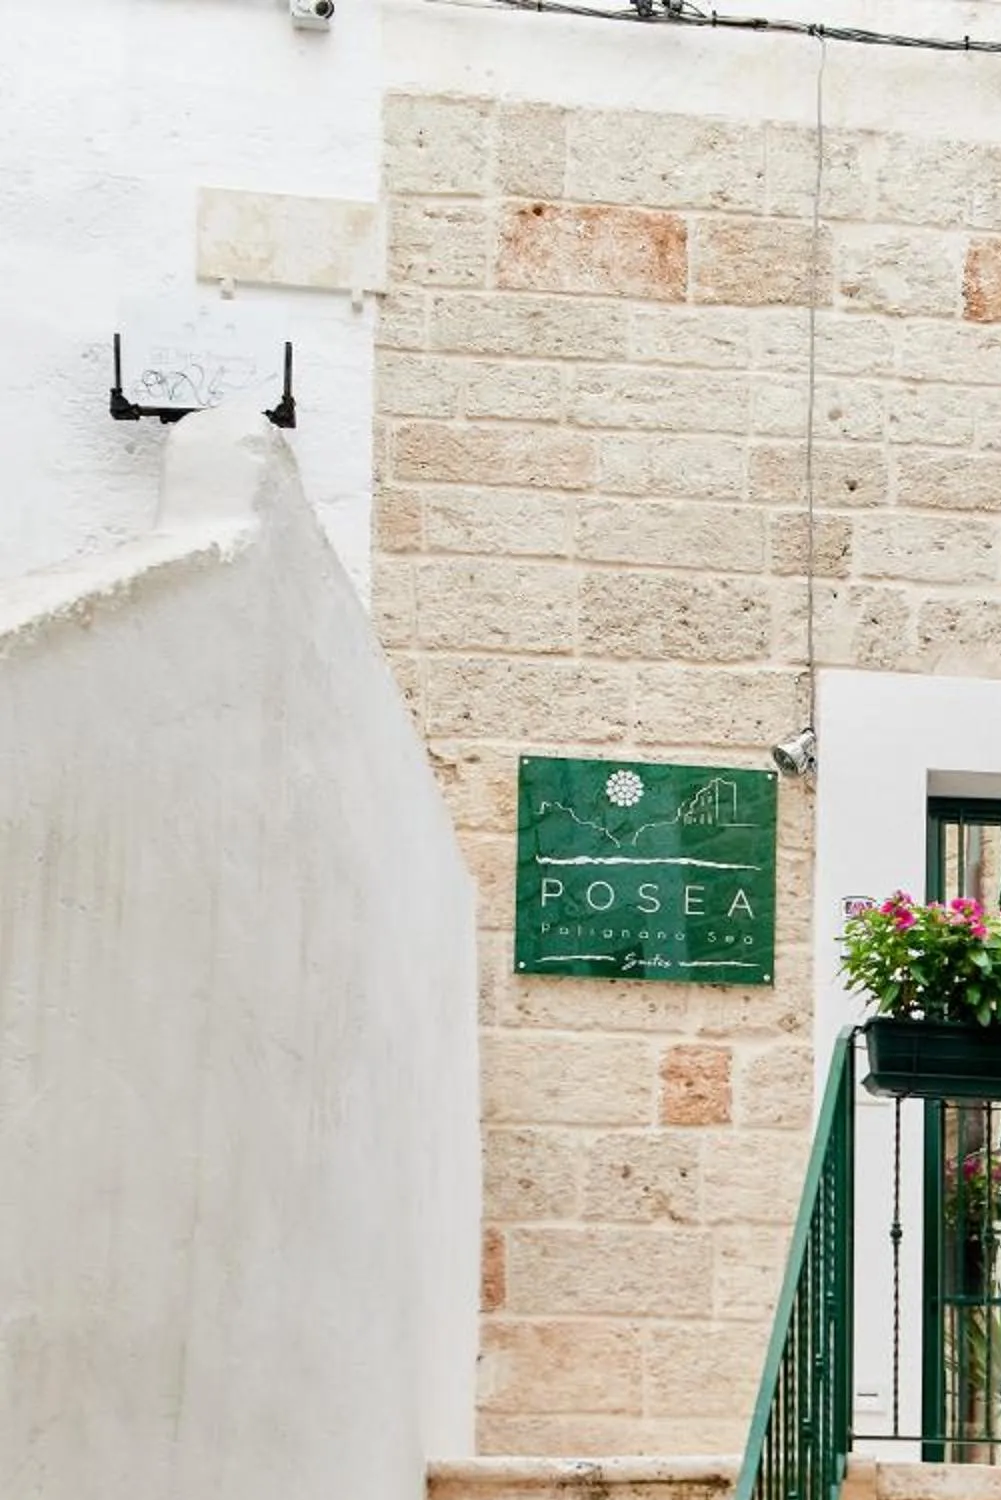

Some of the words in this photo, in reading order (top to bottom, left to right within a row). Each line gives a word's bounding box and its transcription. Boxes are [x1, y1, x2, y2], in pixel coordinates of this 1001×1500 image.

[541, 878, 755, 920] POSEA
[541, 923, 686, 941] Polignano
[707, 931, 754, 945] Sea
